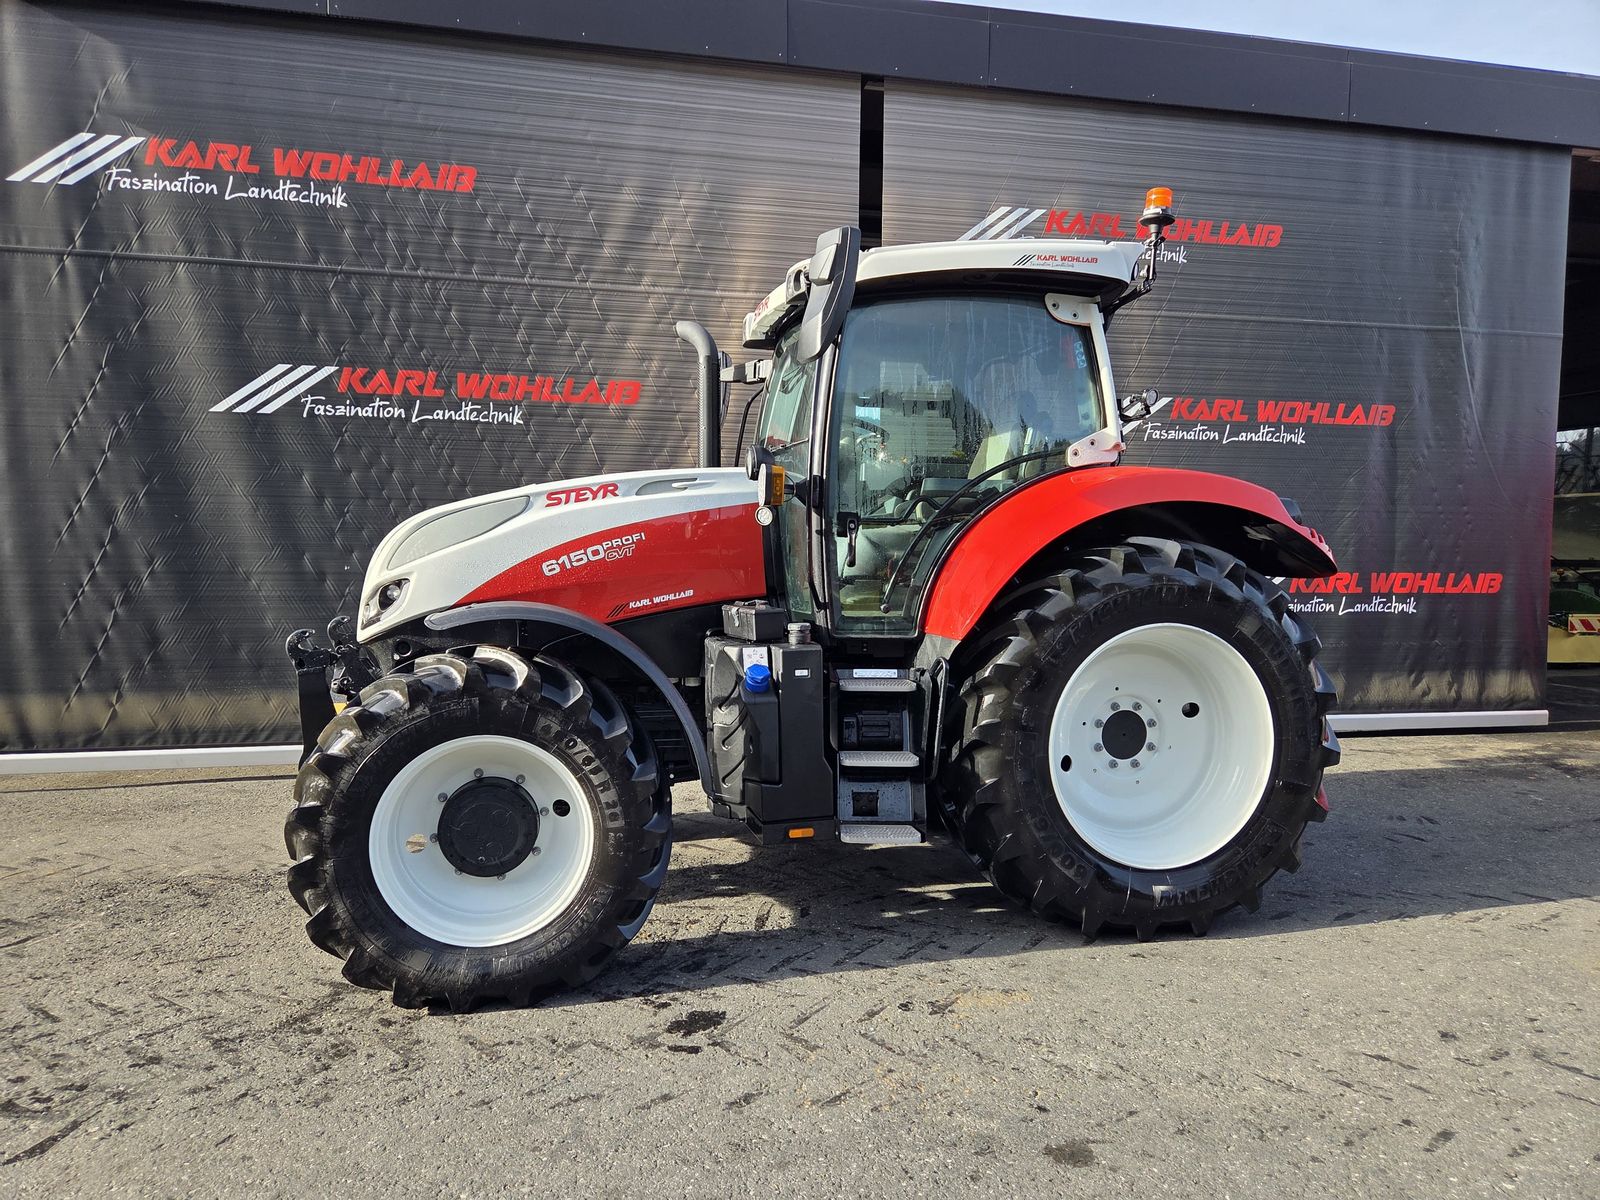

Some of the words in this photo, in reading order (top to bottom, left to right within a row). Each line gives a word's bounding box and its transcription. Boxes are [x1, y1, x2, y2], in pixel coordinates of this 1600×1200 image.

[144, 136, 260, 174] KARL
[273, 147, 477, 193] WOHLLAIB
[105, 166, 218, 196] Faszination
[224, 174, 348, 208] Landtechnik
[1045, 209, 1127, 239] KARL
[1036, 254, 1058, 262] KARL
[337, 366, 445, 398] KARL
[456, 371, 642, 405] WOHLLAIB
[300, 394, 406, 419] Faszination
[411, 399, 524, 425] Landtechnik
[1170, 396, 1249, 422] KARL
[1256, 399, 1396, 427] WOHLLAIB
[1143, 421, 1219, 442] Faszination
[1222, 423, 1306, 445] Landtechnik
[545, 482, 620, 508] STEYR
[541, 544, 605, 577] 6150
[603, 532, 646, 550] PROFI
[605, 544, 636, 562] CVT
[1289, 572, 1362, 594] KARL
[1370, 572, 1503, 594] WOHLLAIB
[629, 598, 652, 609] KARL
[1288, 595, 1335, 613] zination
[1339, 595, 1417, 616] Landtechnik
